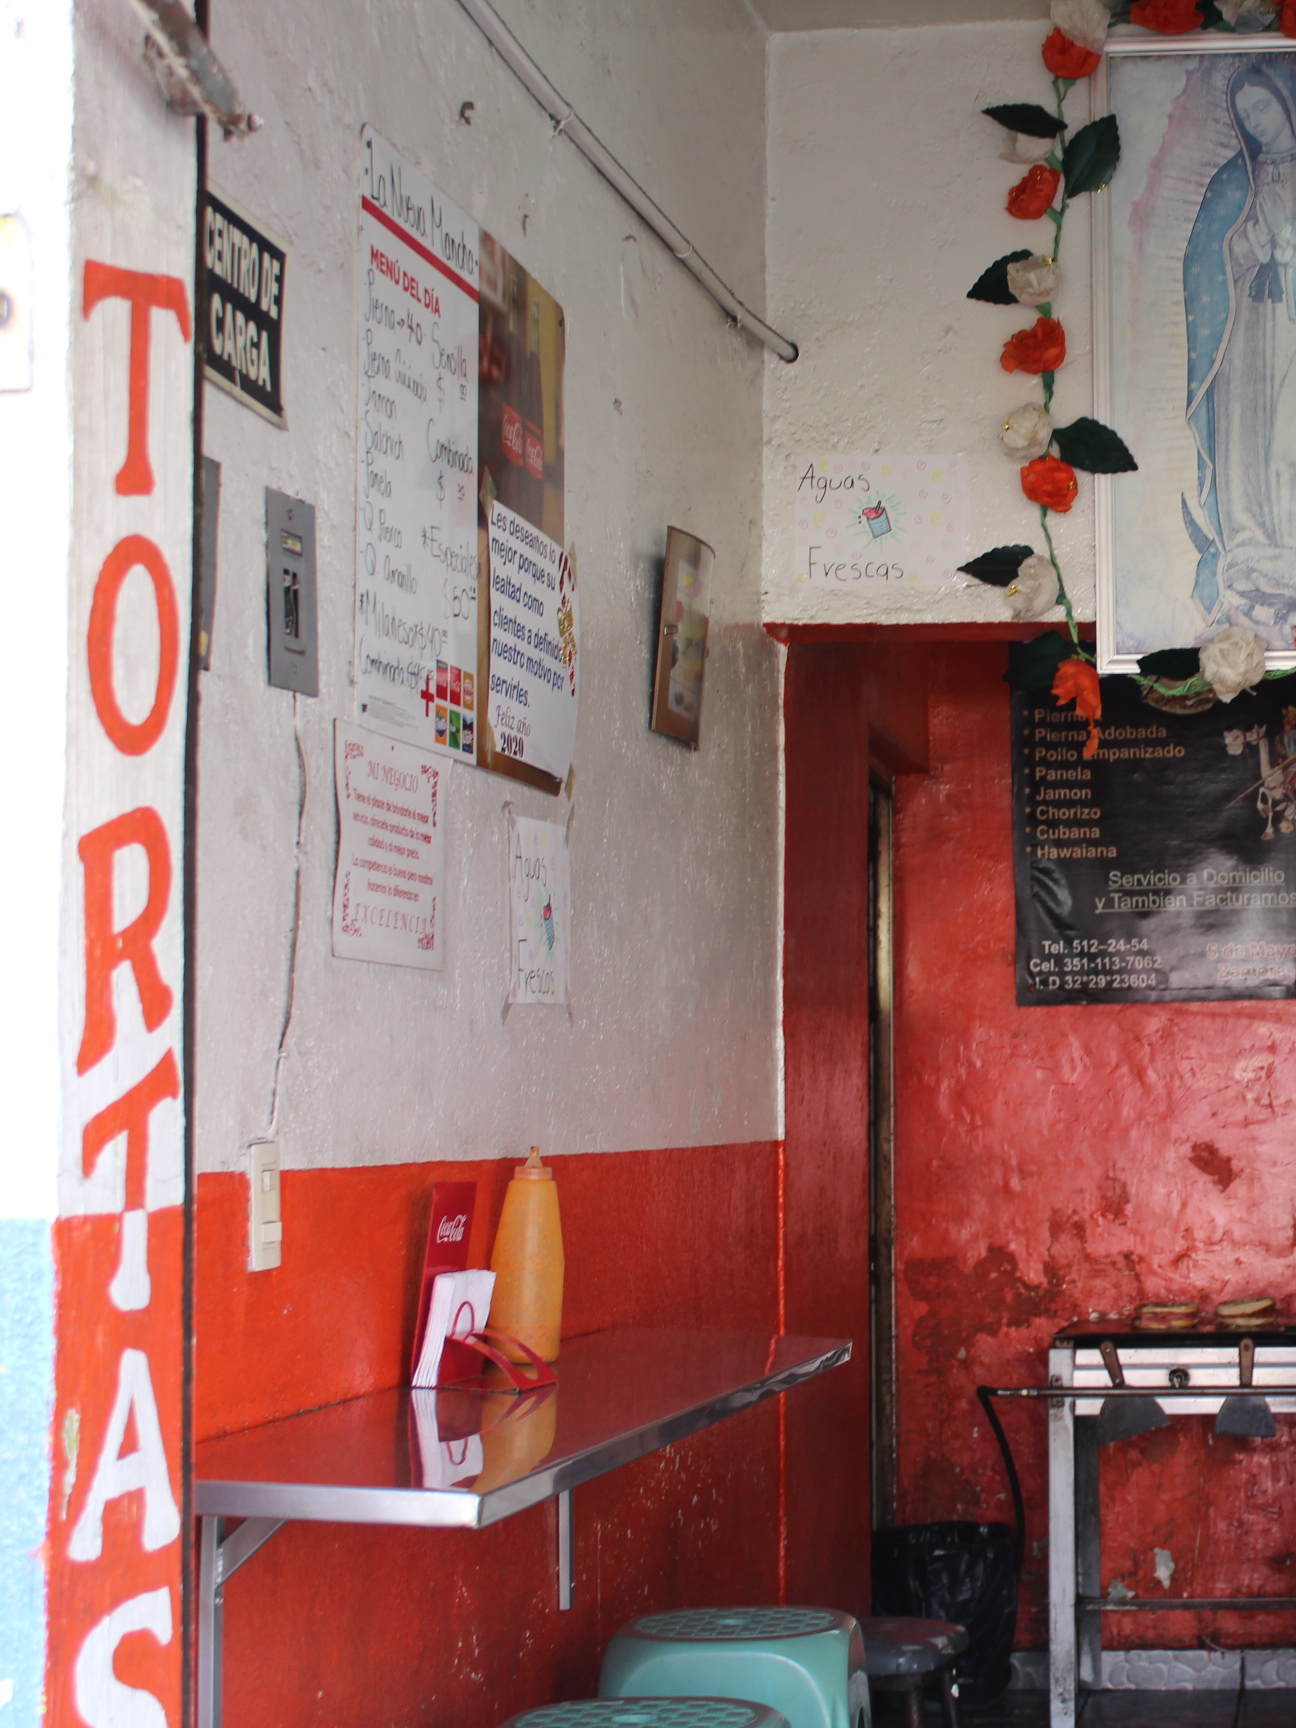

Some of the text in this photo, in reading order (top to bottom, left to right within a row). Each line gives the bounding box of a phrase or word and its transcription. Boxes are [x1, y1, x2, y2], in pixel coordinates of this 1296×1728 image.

[371, 138, 388, 208] La
[390, 164, 427, 238] Nueva
[205, 205, 281, 320] CENTRO DE
[370, 244, 441, 319] MENÚ DEL DÍA
[210, 292, 271, 392] CARGA
[798, 463, 870, 504] Aguas
[491, 503, 556, 564] Les deseamos lo
[491, 537, 556, 591] mejor porque su
[809, 546, 904, 581] Frescas
[492, 568, 544, 617] lealtad como
[493, 605, 526, 642] clientes
[527, 629, 532, 645] a
[526, 655, 550, 684] motivo
[491, 674, 530, 708] servirles.
[494, 705, 531, 738] Feliz año
[1035, 728, 1087, 742] Pierna
[500, 731, 525, 758] 2020
[1035, 747, 1078, 761] Pollo
[368, 760, 419, 793] MI NEGOCIO
[1035, 766, 1091, 781] Panela
[1035, 787, 1092, 801] Jamon
[1036, 805, 1101, 820] Chorizo
[1036, 825, 1100, 840] Cubana
[1037, 844, 1117, 859] Hawaiana
[514, 832, 547, 902] Aguas
[1108, 867, 1285, 887] Servicio a Domicilio
[1095, 897, 1106, 913] y
[1110, 892, 1187, 910] Tambien
[353, 903, 426, 934] EXCELENCIA
[1042, 941, 1068, 955] Tel.
[1206, 942, 1218, 959] 5
[1221, 942, 1245, 959] de
[518, 939, 556, 997] Frescas
[1030, 956, 1162, 972] Cel. 351-113-7062
[1049, 976, 1060, 989] D
[437, 1214, 467, 1243] Coca-Cola
